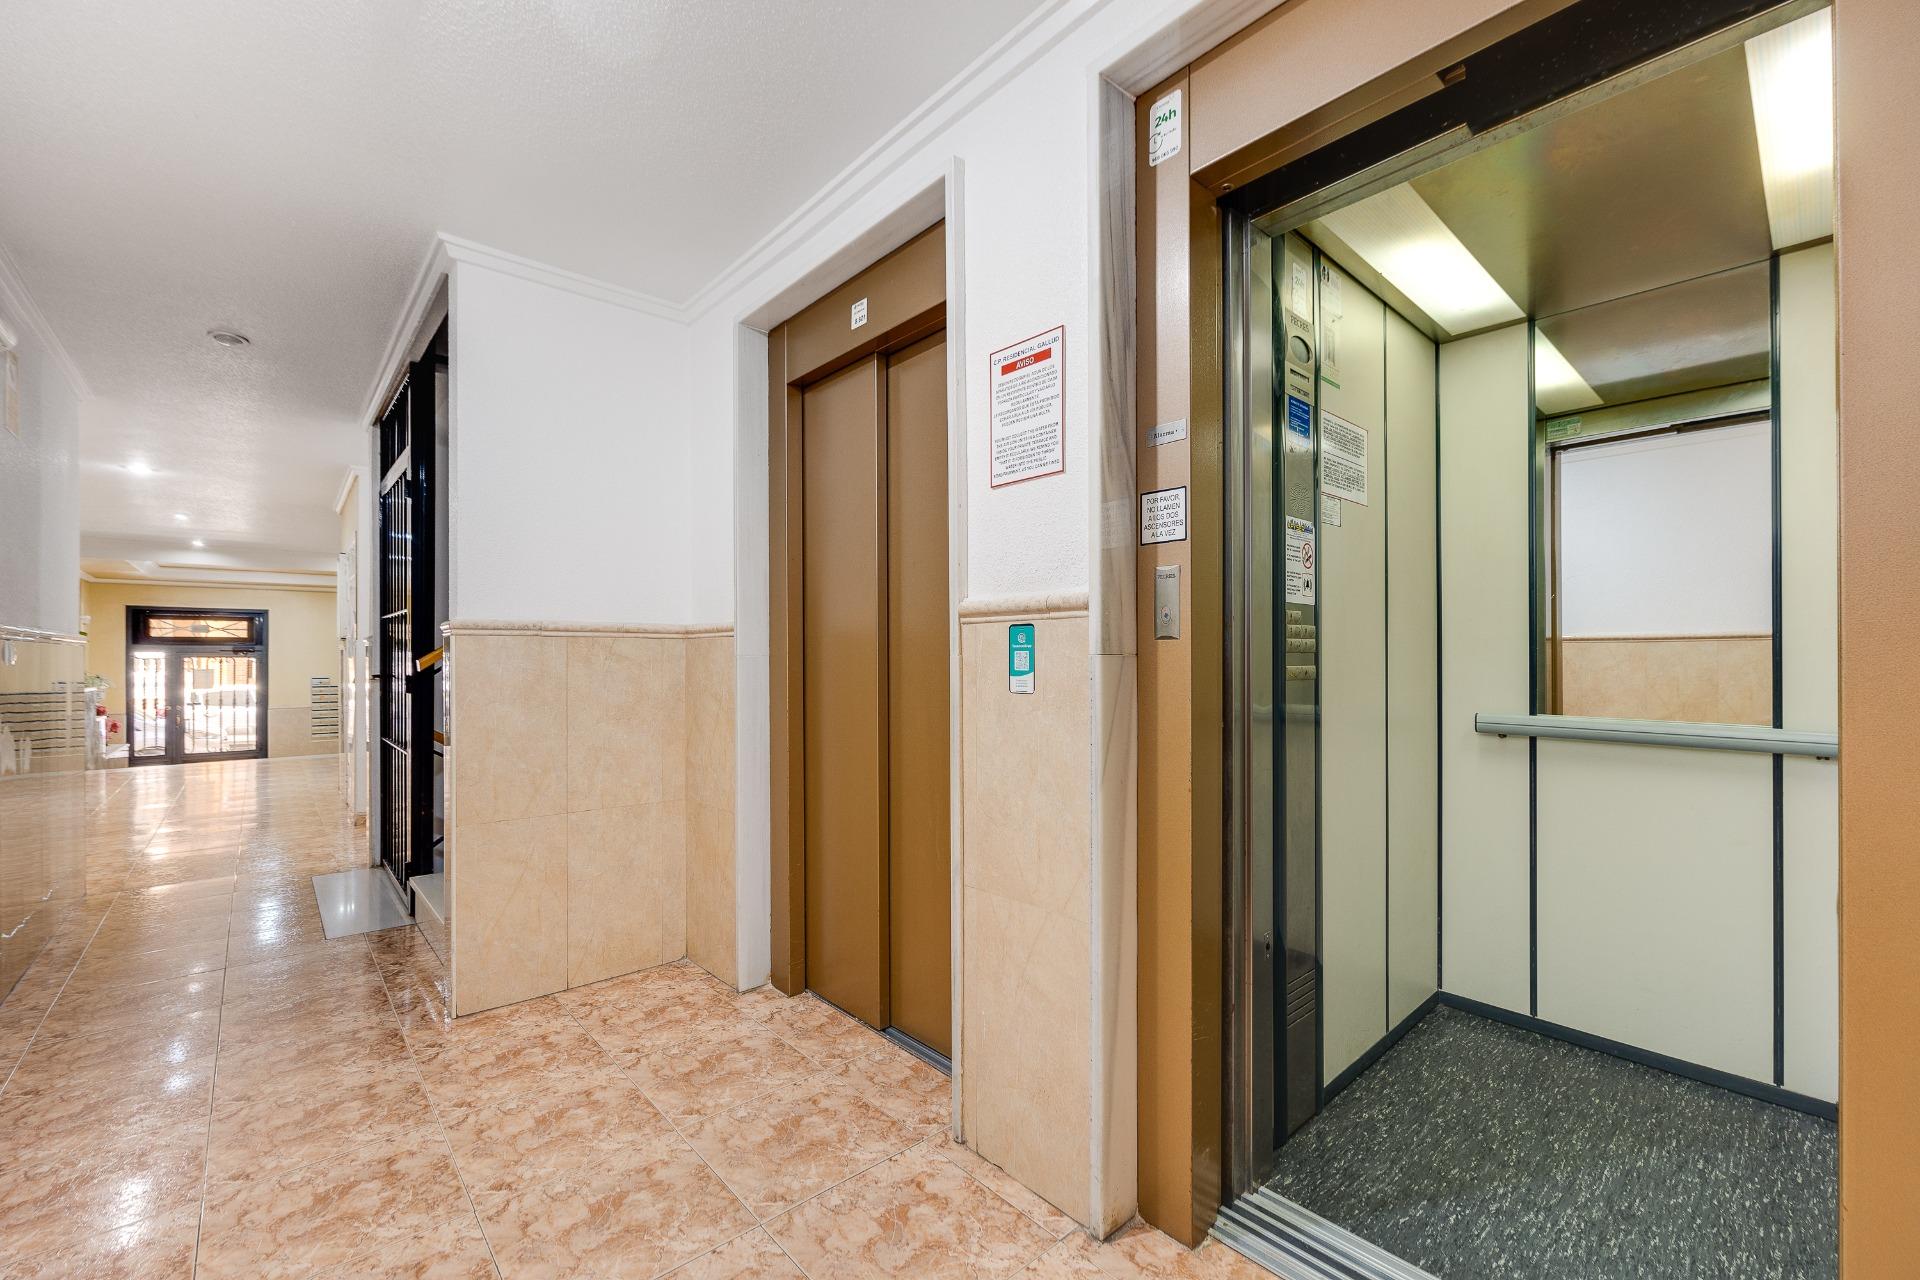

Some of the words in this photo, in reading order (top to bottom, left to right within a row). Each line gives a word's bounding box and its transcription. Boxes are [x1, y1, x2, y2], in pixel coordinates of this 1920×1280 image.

[1154, 109, 1177, 129] 24h
[1003, 345, 1036, 362] RESIDENCIAL
[1037, 336, 1059, 349] GALLUD
[1016, 357, 1034, 369] AVISO
[1147, 497, 1158, 505] POR
[1159, 494, 1180, 503] FAVOR
[1157, 503, 1180, 512] LLAMEN
[1153, 513, 1164, 521] LOS
[1166, 511, 1178, 519] DOS
[1144, 519, 1183, 530] ASCENSORES
